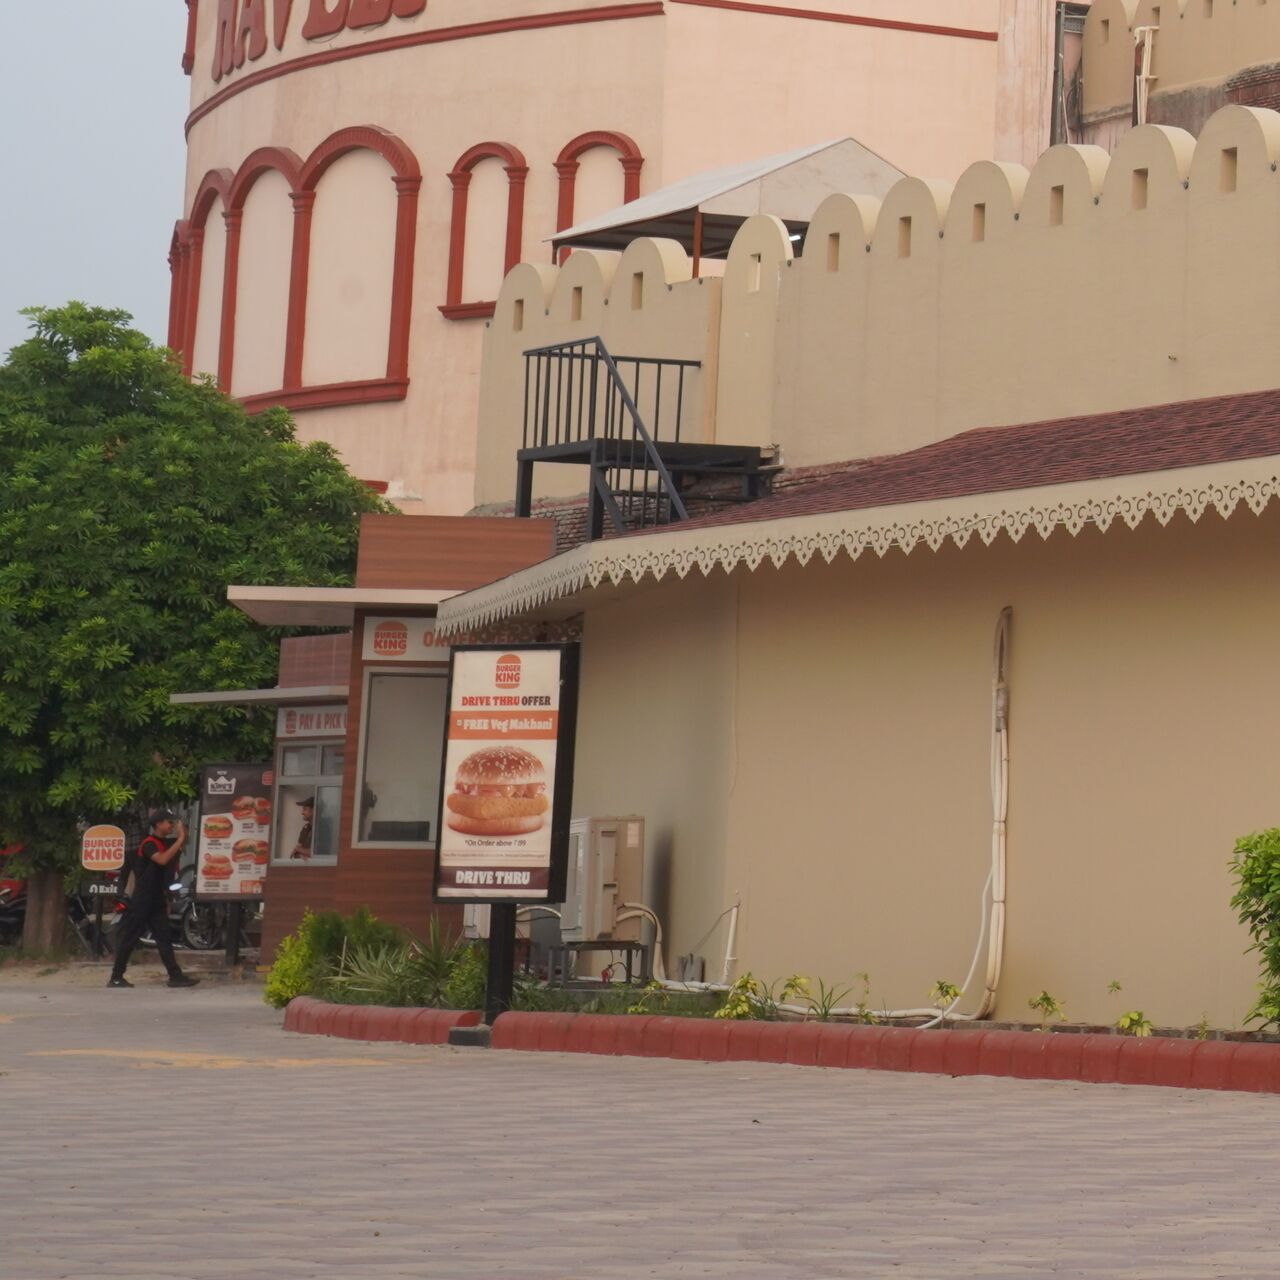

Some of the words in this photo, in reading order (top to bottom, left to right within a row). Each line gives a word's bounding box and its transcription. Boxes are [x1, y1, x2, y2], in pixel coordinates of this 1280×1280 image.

[374, 631, 408, 639] BURGER
[374, 638, 407, 650] KING
[496, 664, 521, 673] BURGER
[496, 672, 520, 682] KING
[461, 696, 491, 706] DRIVE
[493, 696, 520, 706] THRU
[521, 695, 552, 706] OFFER
[463, 719, 489, 730] FREE
[491, 719, 509, 733] Veg
[84, 839, 123, 848] BURGER
[83, 848, 123, 860] KING
[455, 870, 494, 885] DRIVE
[495, 871, 531, 885] THRU
[98, 884, 118, 893] Exit
